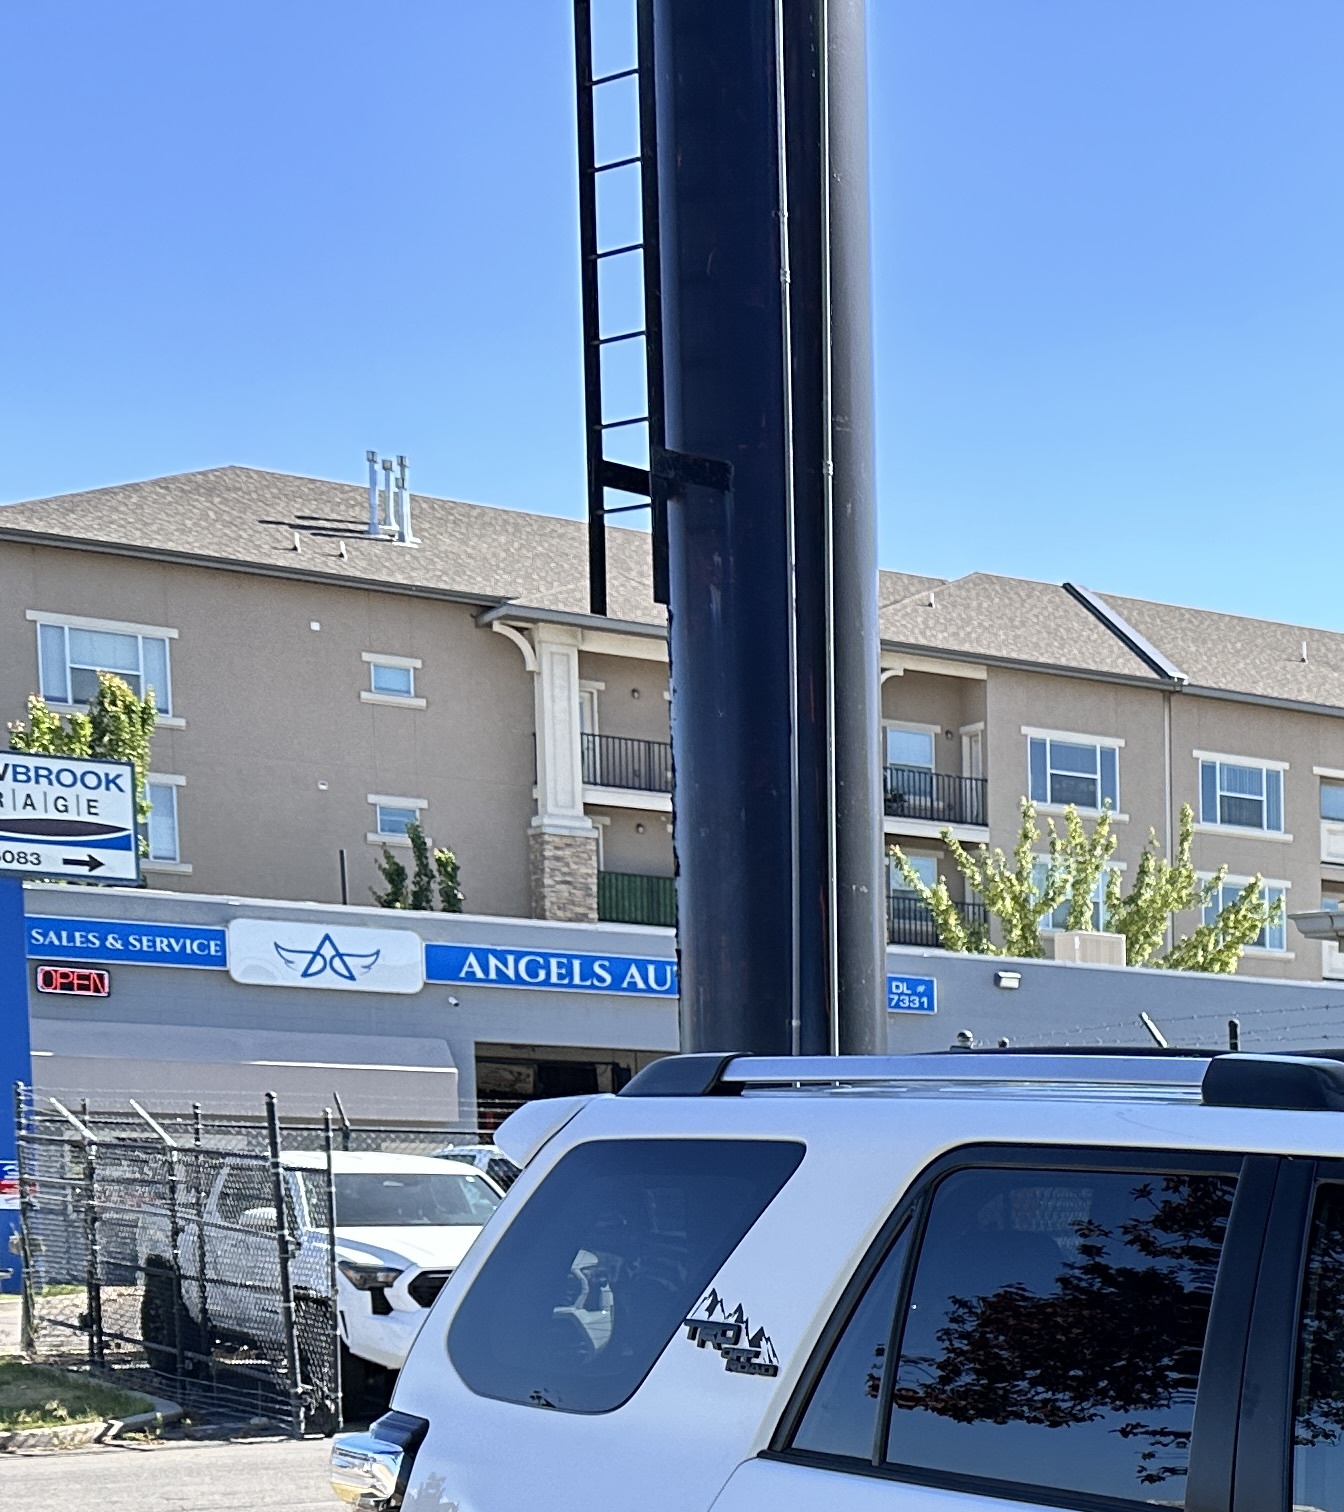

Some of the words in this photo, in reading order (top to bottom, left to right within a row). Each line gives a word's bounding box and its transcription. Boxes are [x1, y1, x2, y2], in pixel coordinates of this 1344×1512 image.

[0, 850, 42, 866] 083
[31, 928, 100, 949] SALES
[105, 933, 124, 950] &
[128, 934, 222, 956] SERVICE
[39, 967, 108, 994] OPEN
[459, 951, 613, 988] ANGELS
[621, 963, 678, 992] AU
[891, 980, 912, 994] DL
[888, 993, 928, 1009] 7331
